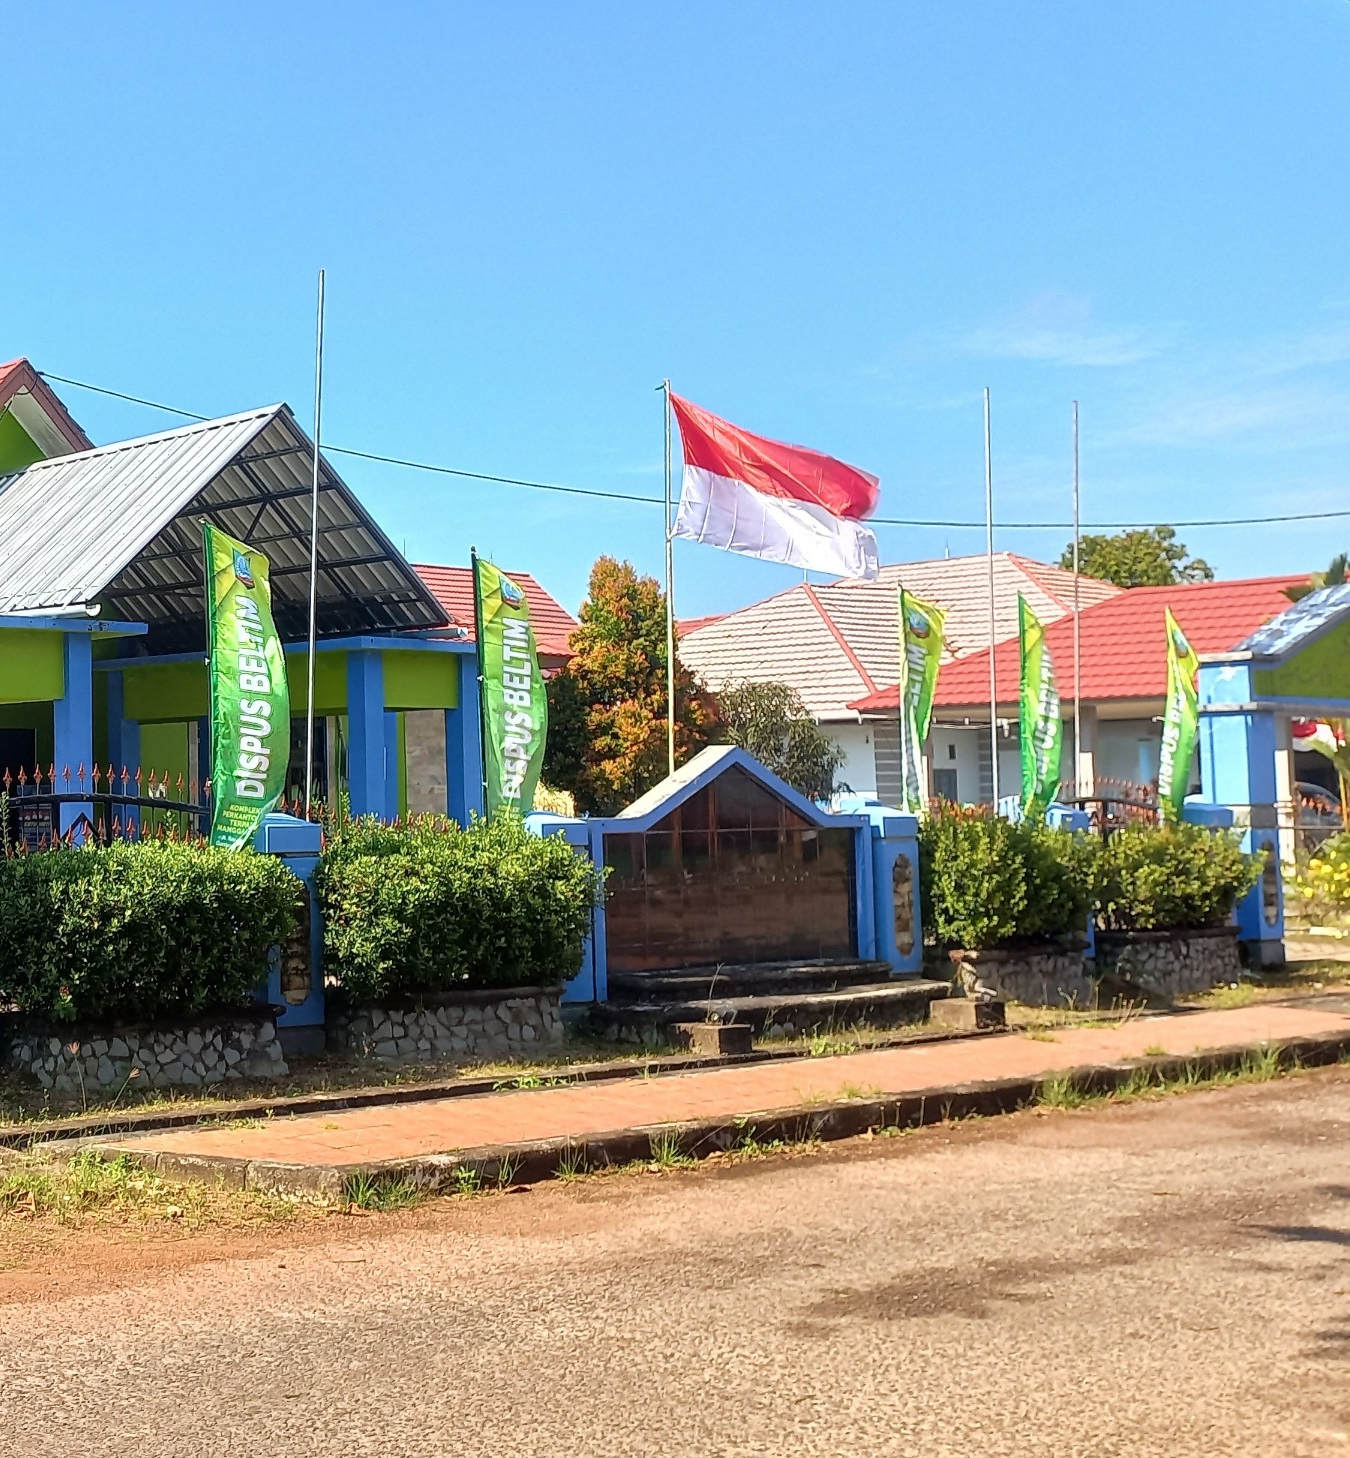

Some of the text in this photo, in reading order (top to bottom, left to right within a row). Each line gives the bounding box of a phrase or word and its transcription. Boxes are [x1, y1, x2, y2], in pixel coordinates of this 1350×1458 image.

[502, 616, 532, 708] BELTIM
[234, 594, 273, 800] DISPUS BELTIM
[222, 810, 257, 822] PERKANTO
[216, 824, 248, 835] MANGGA
[229, 819, 253, 829] TERPA
